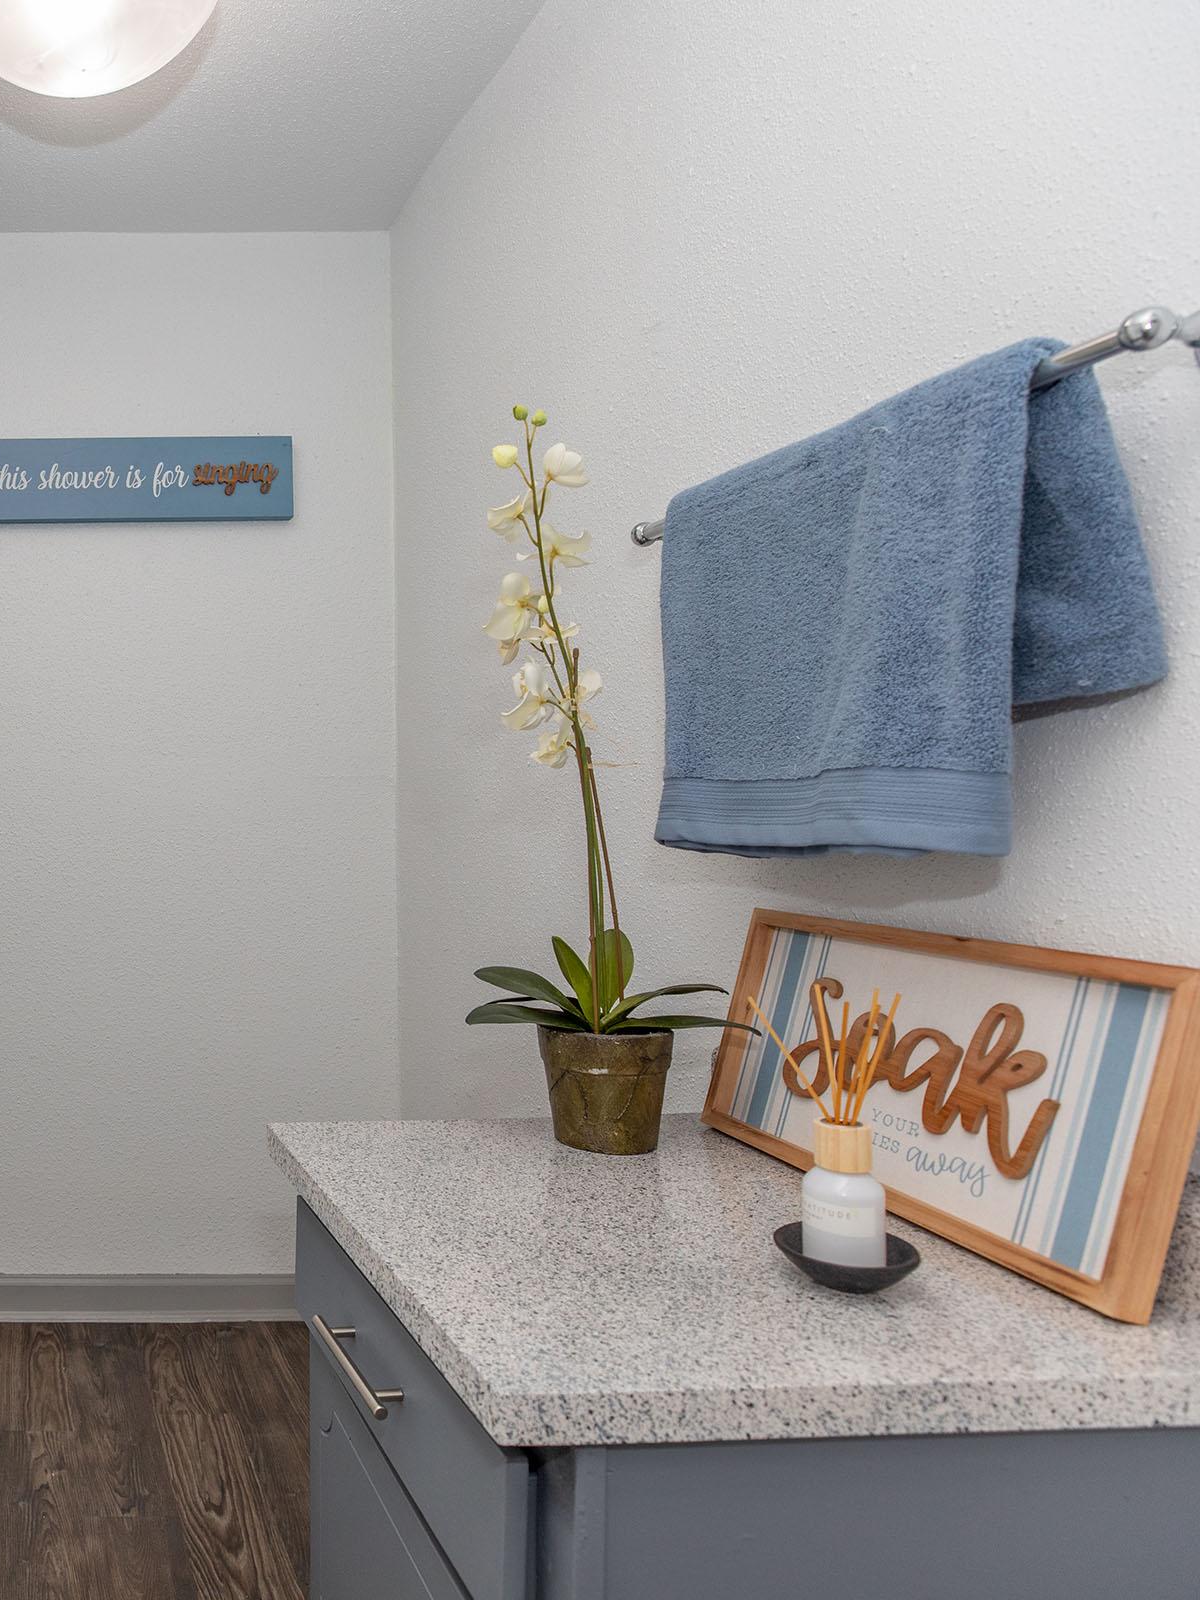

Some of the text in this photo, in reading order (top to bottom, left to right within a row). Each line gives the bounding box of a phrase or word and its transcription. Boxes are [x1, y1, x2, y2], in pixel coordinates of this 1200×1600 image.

[37, 463, 120, 490] shower
[125, 464, 146, 489] is
[152, 462, 190, 498] for
[192, 460, 279, 496] singing
[872, 1107, 920, 1138] YOUR
[906, 1146, 991, 1198] away
